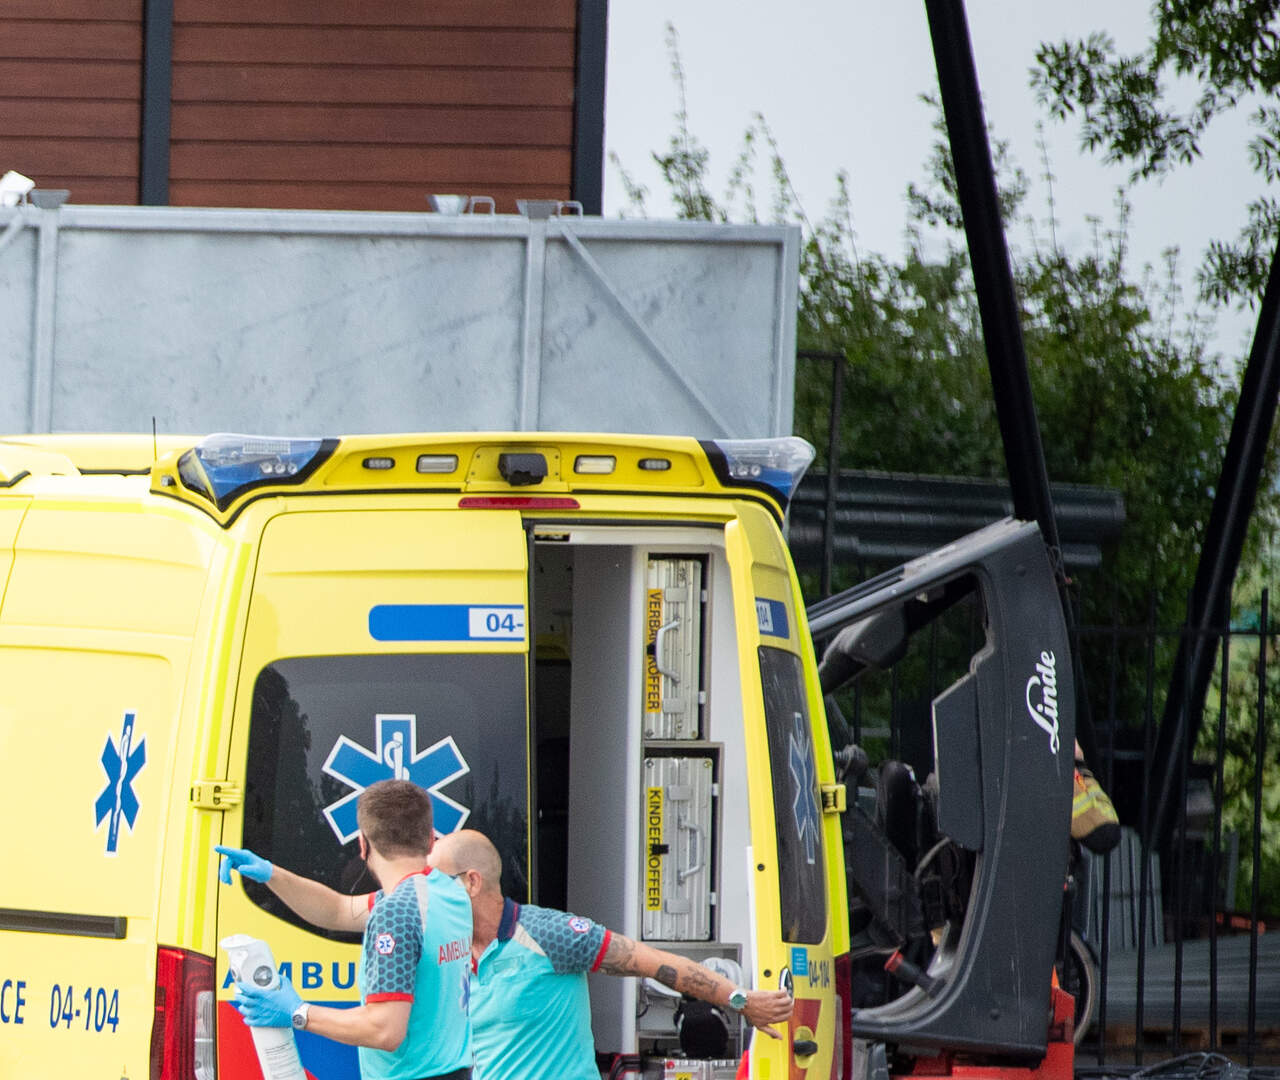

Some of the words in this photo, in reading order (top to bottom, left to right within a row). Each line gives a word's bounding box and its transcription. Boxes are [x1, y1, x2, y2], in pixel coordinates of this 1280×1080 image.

[648, 591, 662, 711] VERBAKOFFER
[1025, 650, 1061, 756] Linde
[648, 788, 662, 908] KINDEROFFER
[49, 983, 120, 1034] 04-104
